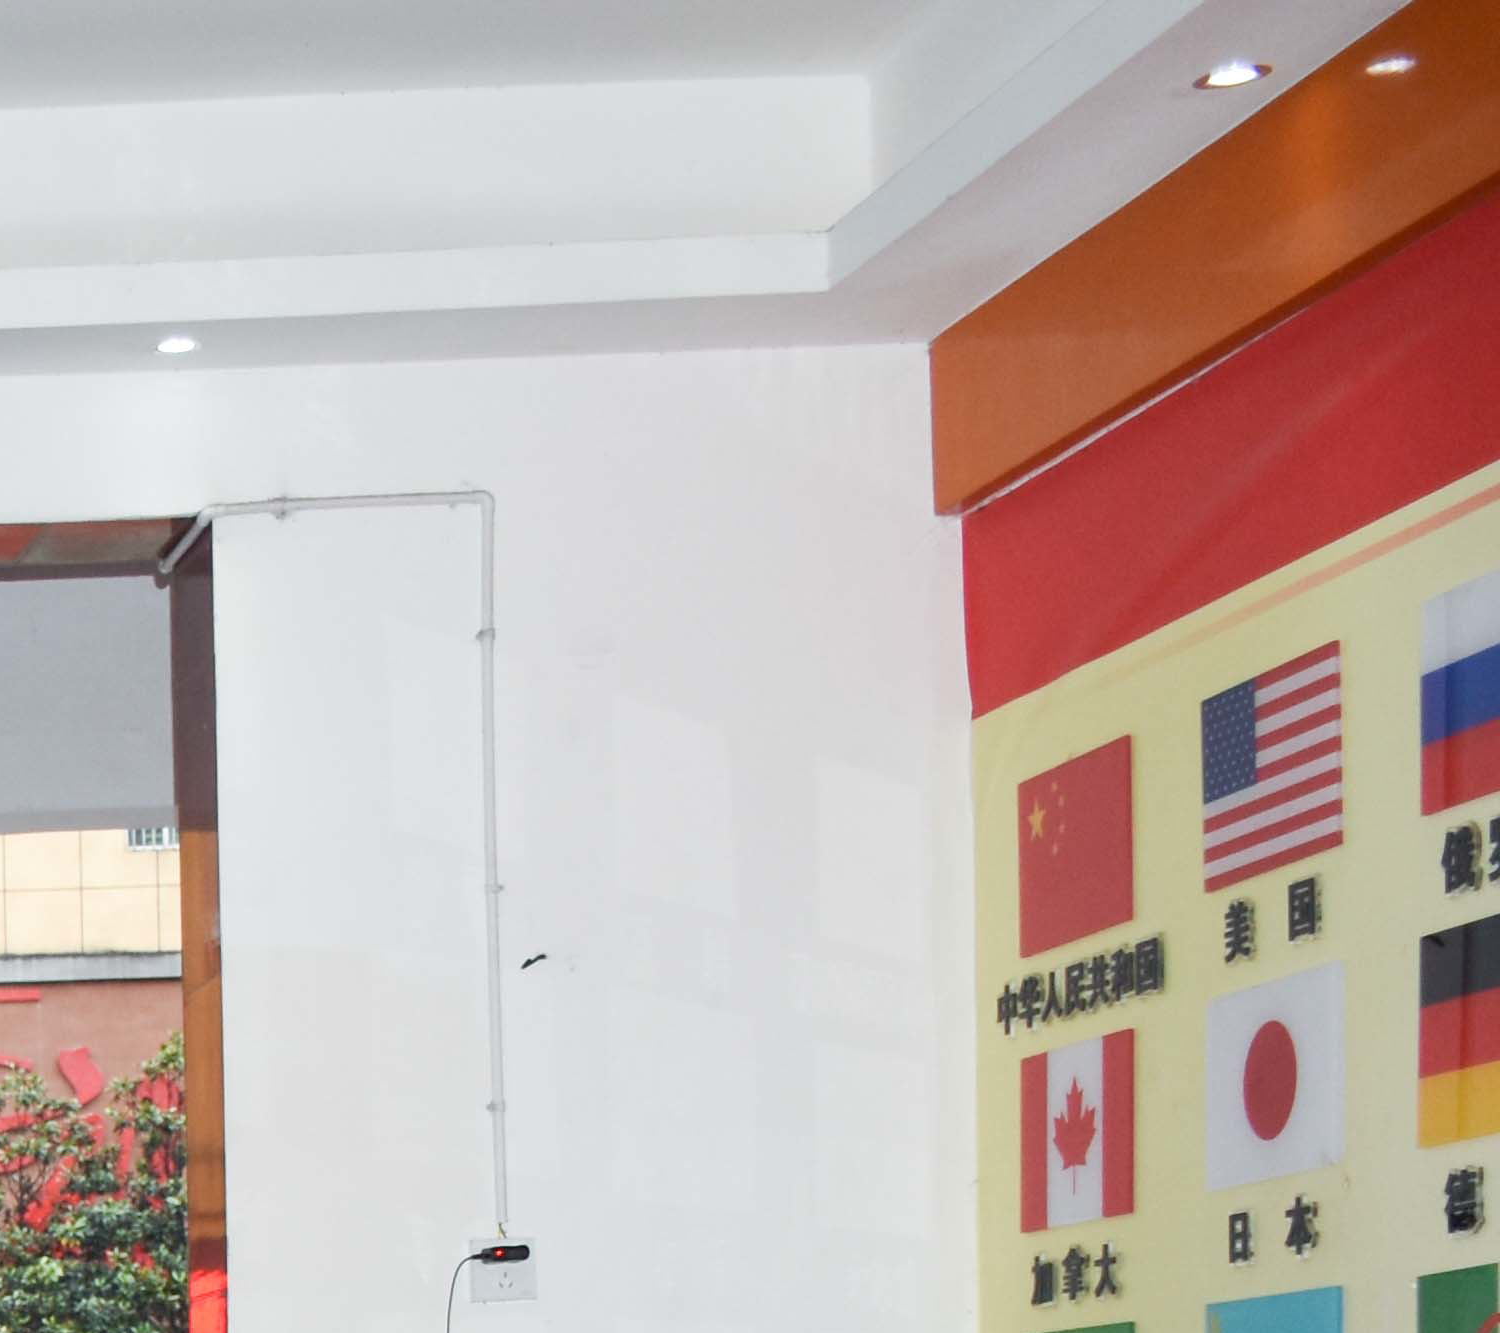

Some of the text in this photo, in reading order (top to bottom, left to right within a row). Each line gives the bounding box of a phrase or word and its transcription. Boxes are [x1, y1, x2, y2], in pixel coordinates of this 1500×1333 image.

[1222, 876, 1322, 964] 美国
[997, 932, 1165, 1036] 中华人民共和国
[1227, 1193, 1320, 1267] 日本
[1444, 1165, 1485, 1240] 德
[1031, 1242, 1119, 1306] 加拿大
